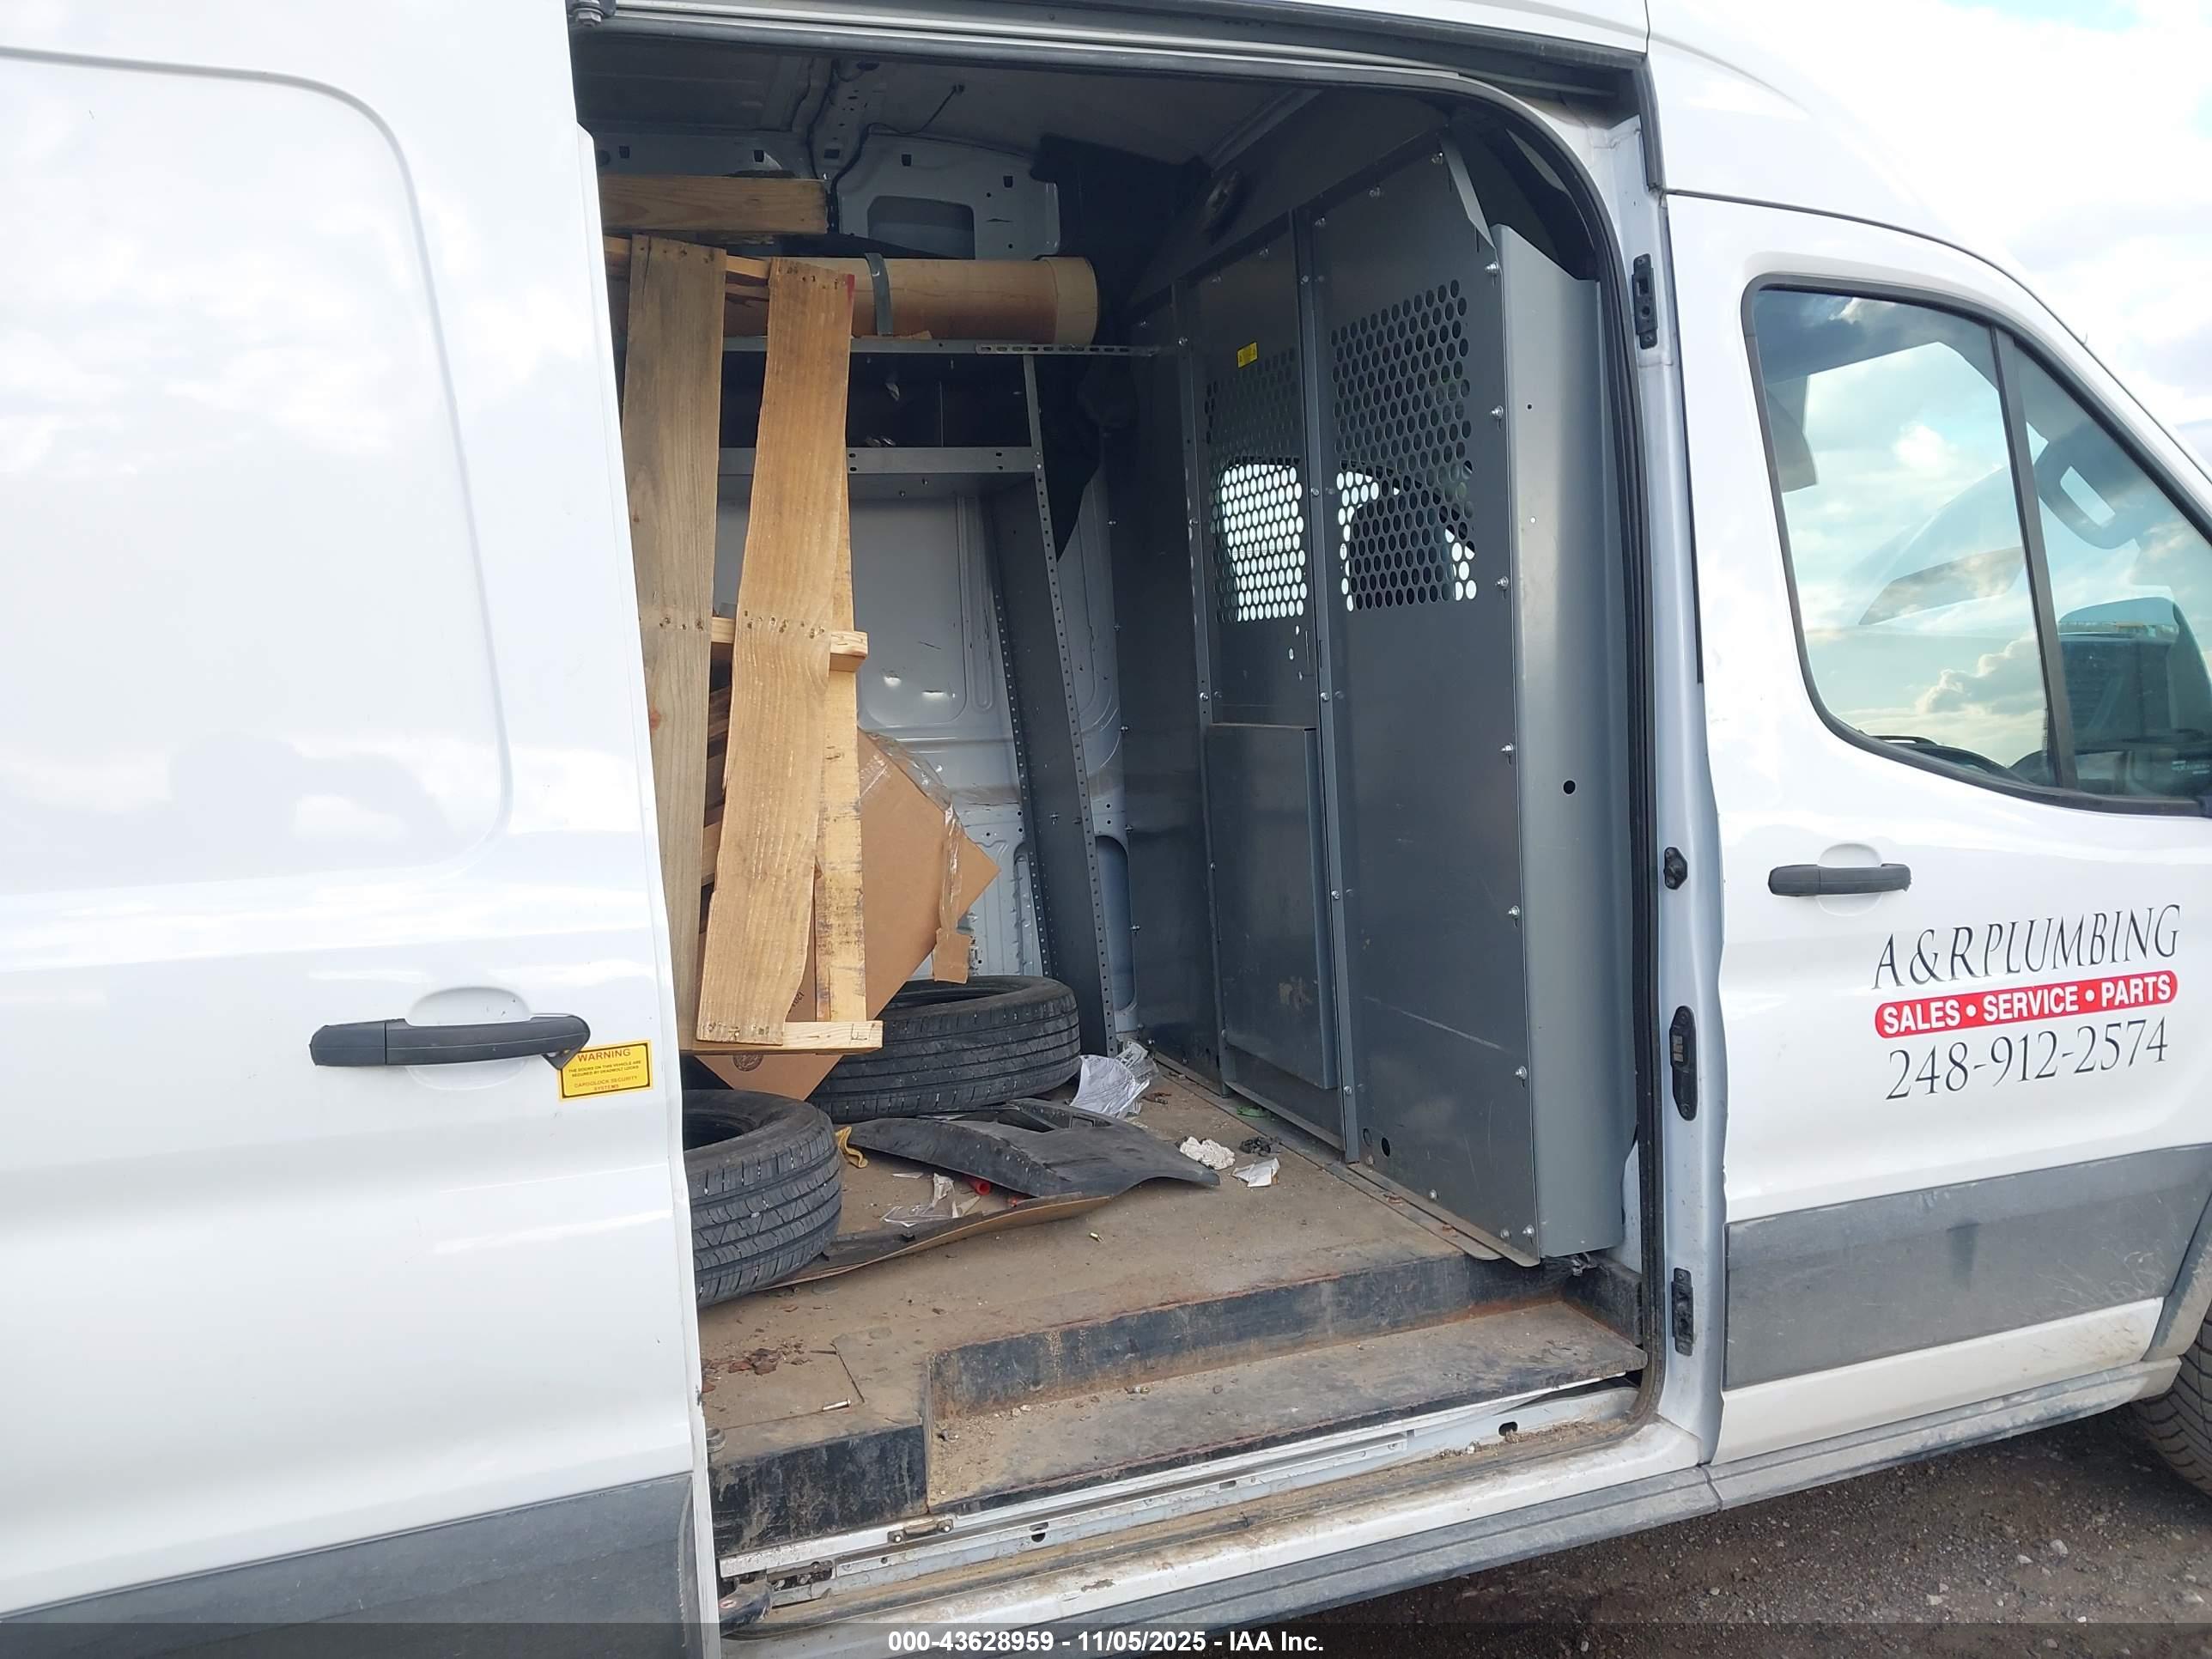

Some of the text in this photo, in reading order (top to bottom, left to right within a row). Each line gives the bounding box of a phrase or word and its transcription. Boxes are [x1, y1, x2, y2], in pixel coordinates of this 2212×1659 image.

[1883, 975, 2171, 1035] SALES SERVICE PARTS
[577, 1048, 631, 1062] WARNING
[1886, 1016, 2168, 1100] 248-912-2574
